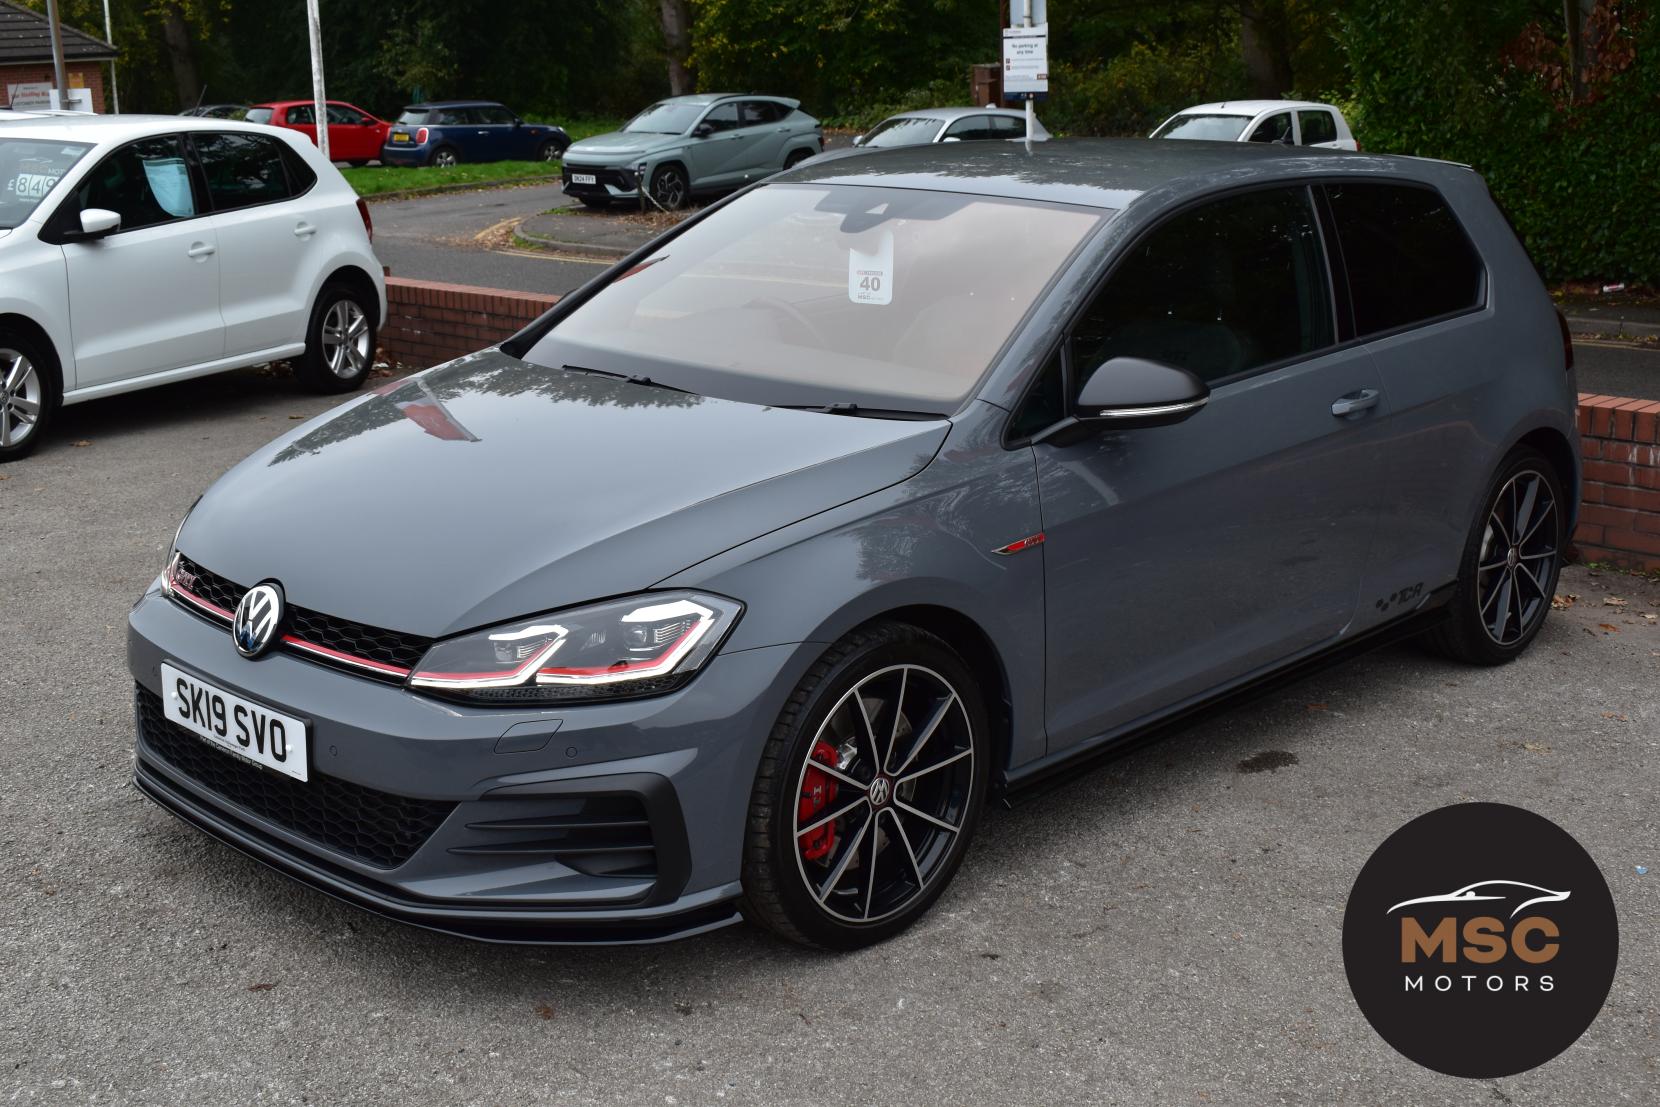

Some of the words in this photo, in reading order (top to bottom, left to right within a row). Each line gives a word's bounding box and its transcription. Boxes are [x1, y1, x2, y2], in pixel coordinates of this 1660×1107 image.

[860, 276, 880, 291] 40
[176, 677, 228, 738] SK19
[233, 704, 288, 763] SVO
